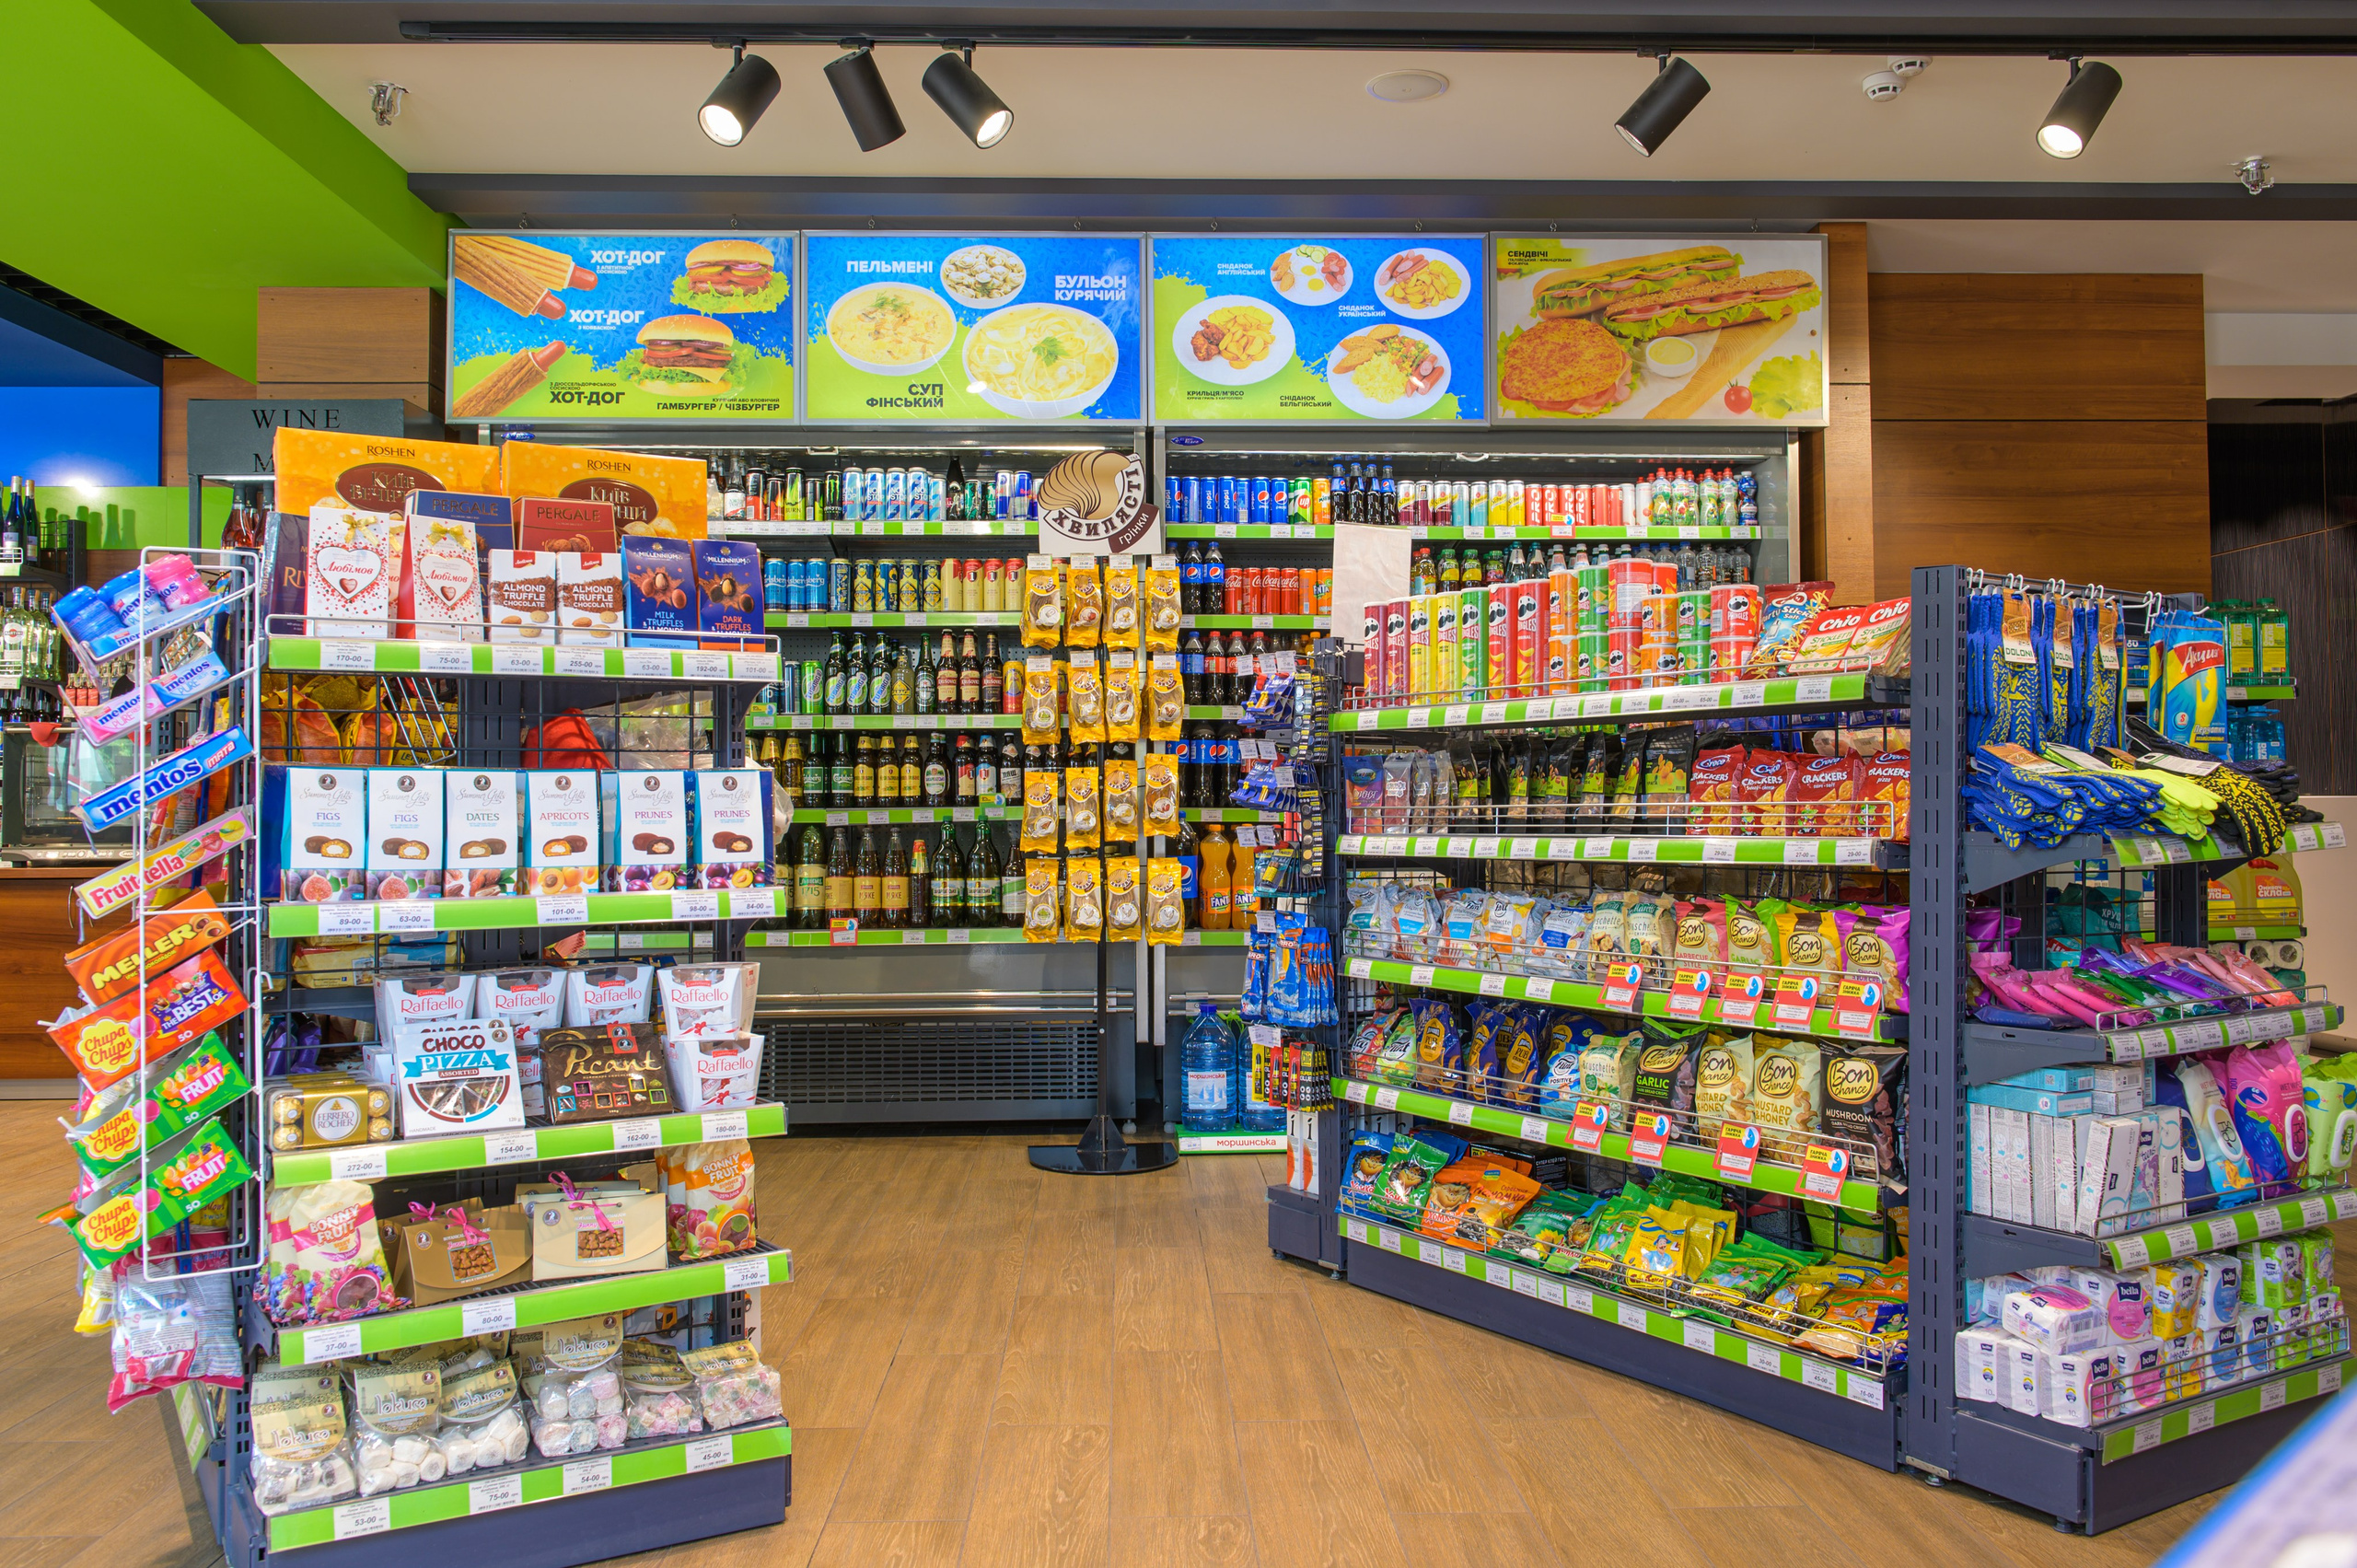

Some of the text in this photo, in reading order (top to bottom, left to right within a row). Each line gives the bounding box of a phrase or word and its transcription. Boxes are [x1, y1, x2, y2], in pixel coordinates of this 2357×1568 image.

[591, 250, 666, 265] ХОТ-ДОГ
[847, 261, 933, 273] ПЕЛЬМЕНІ
[1055, 276, 1126, 289] БУЛЬОН
[1055, 288, 1126, 301] КУРЯЧИЙ
[569, 310, 644, 325] ХОТ-ДОГ
[908, 384, 943, 396] СУП
[550, 392, 625, 406] ХОТ-ДОГ
[866, 396, 943, 408] ФІНСЬКИЙ
[251, 410, 341, 429] WINE
[367, 446, 415, 457] ROSHEN
[587, 459, 631, 471] ROSHEN
[372, 471, 415, 488] КИЇВ
[589, 486, 630, 503] КИЇВ
[433, 498, 498, 517] PERGALE
[1052, 469, 1141, 537] ХВИЛЯСТІ
[538, 506, 600, 522] PERGALE
[1119, 513, 1149, 545] грінки
[638, 551, 679, 561] MILLENNIUM
[707, 556, 747, 564] MILLENNIUM
[324, 562, 373, 575] Любімов
[426, 569, 468, 584] Любімов
[504, 584, 545, 593] ALMOND
[504, 592, 545, 601] TRUFFLE
[573, 593, 613, 602] TRUFFLE
[1727, 611, 1748, 621] PRINGLES
[1869, 600, 1909, 622] Chio
[647, 618, 683, 627] TRUFFLES
[715, 622, 751, 631] TRUFFLES
[1818, 615, 1860, 632] Chio
[1862, 620, 1903, 636] STICKLETTI
[1811, 631, 1852, 645] STICKLETTI
[2005, 648, 2033, 657] DOLONI
[2181, 646, 2218, 673] Акция
[165, 659, 210, 691] mentos
[98, 693, 142, 726] mentos
[2194, 725, 2224, 735] Перчатки
[1802, 772, 1847, 783] CRACKERS
[99, 759, 203, 822] mentos
[300, 788, 353, 807] Summer Gifts
[378, 790, 431, 807] Summer Gifts
[317, 812, 341, 820] FIGS
[394, 814, 418, 822] FIGS
[466, 813, 499, 821] DATES
[540, 812, 589, 820] APRICOTS
[801, 886, 819, 896] 1715
[1235, 893, 1256, 904] FANTA
[1679, 922, 1703, 937] Bon
[1680, 935, 1702, 944] chance
[1849, 937, 1879, 956] Bon
[1790, 938, 1820, 956] Bon
[92, 923, 198, 990] MELLER
[1794, 951, 1818, 961] chance
[496, 992, 555, 1010] Raffaello
[585, 990, 642, 1005] Raffaello
[161, 990, 225, 1030] THE BEST OF
[401, 999, 463, 1013] Raffaello
[85, 1025, 126, 1053] Chupa
[423, 1035, 485, 1052] CHOCO
[89, 1029, 192, 1065] Chups 50
[420, 1052, 494, 1072] PIZZA
[549, 1041, 662, 1078] Picant
[440, 1069, 479, 1077] ASSORTED
[180, 1065, 225, 1102] FRUIT
[1637, 1075, 1669, 1089] GARLIC
[1756, 1101, 1793, 1115] MUSTARD
[184, 1110, 200, 1124] 50
[318, 1111, 354, 1121] FERRERO
[1756, 1110, 1789, 1126] &HONEY
[1826, 1108, 1873, 1123] MUSHROOM
[317, 1118, 354, 1128] ROCHER
[93, 1122, 136, 1153] Chups
[1217, 1138, 1277, 1148] моршинська
[500, 1145, 524, 1154] 154-00
[347, 1163, 373, 1171] 272-00
[702, 1153, 740, 1175] BONNY
[181, 1155, 226, 1191] FRUIT
[88, 1202, 131, 1230] Chupa
[94, 1200, 201, 1243] Chups 50
[309, 1204, 360, 1233] BONNY
[318, 1221, 355, 1244] FRUIT
[741, 1272, 759, 1281] 31-00
[2224, 1272, 2235, 1281] bella
[2121, 1287, 2139, 1296] bella
[482, 1316, 503, 1324] 80-00
[325, 1342, 347, 1351] 37-00
[2095, 1364, 2107, 1372] bella
[1814, 1375, 1829, 1383] 45-00
[702, 1451, 722, 1460] 45-00
[581, 1474, 600, 1482] 54-00
[489, 1492, 509, 1501] 75-00
[354, 1516, 376, 1526] 53-00
